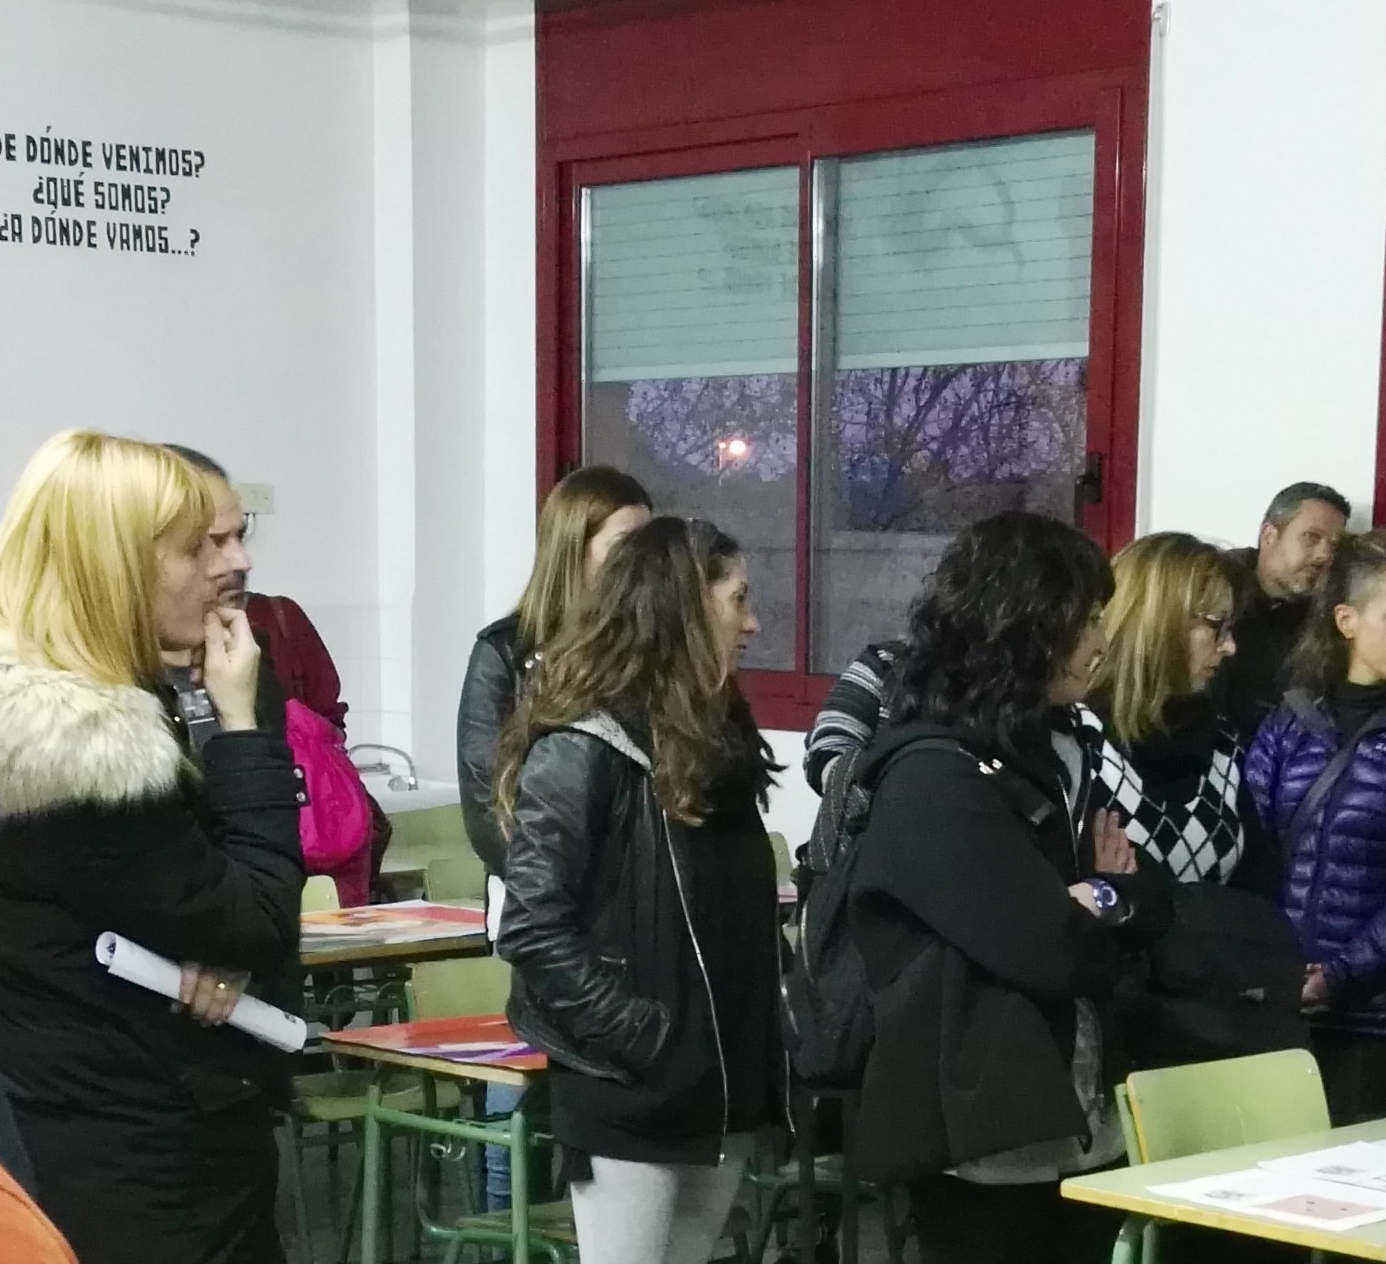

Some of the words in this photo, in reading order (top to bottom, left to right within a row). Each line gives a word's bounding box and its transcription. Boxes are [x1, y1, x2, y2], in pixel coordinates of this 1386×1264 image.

[25, 126, 93, 168] DÓNDE
[102, 143, 205, 178] VENIMOS?
[32, 171, 85, 209] ¿QUÉ
[94, 182, 171, 214] SOMOS?
[31, 210, 97, 248] DÓNDE
[106, 222, 200, 256] VAMOS...?
